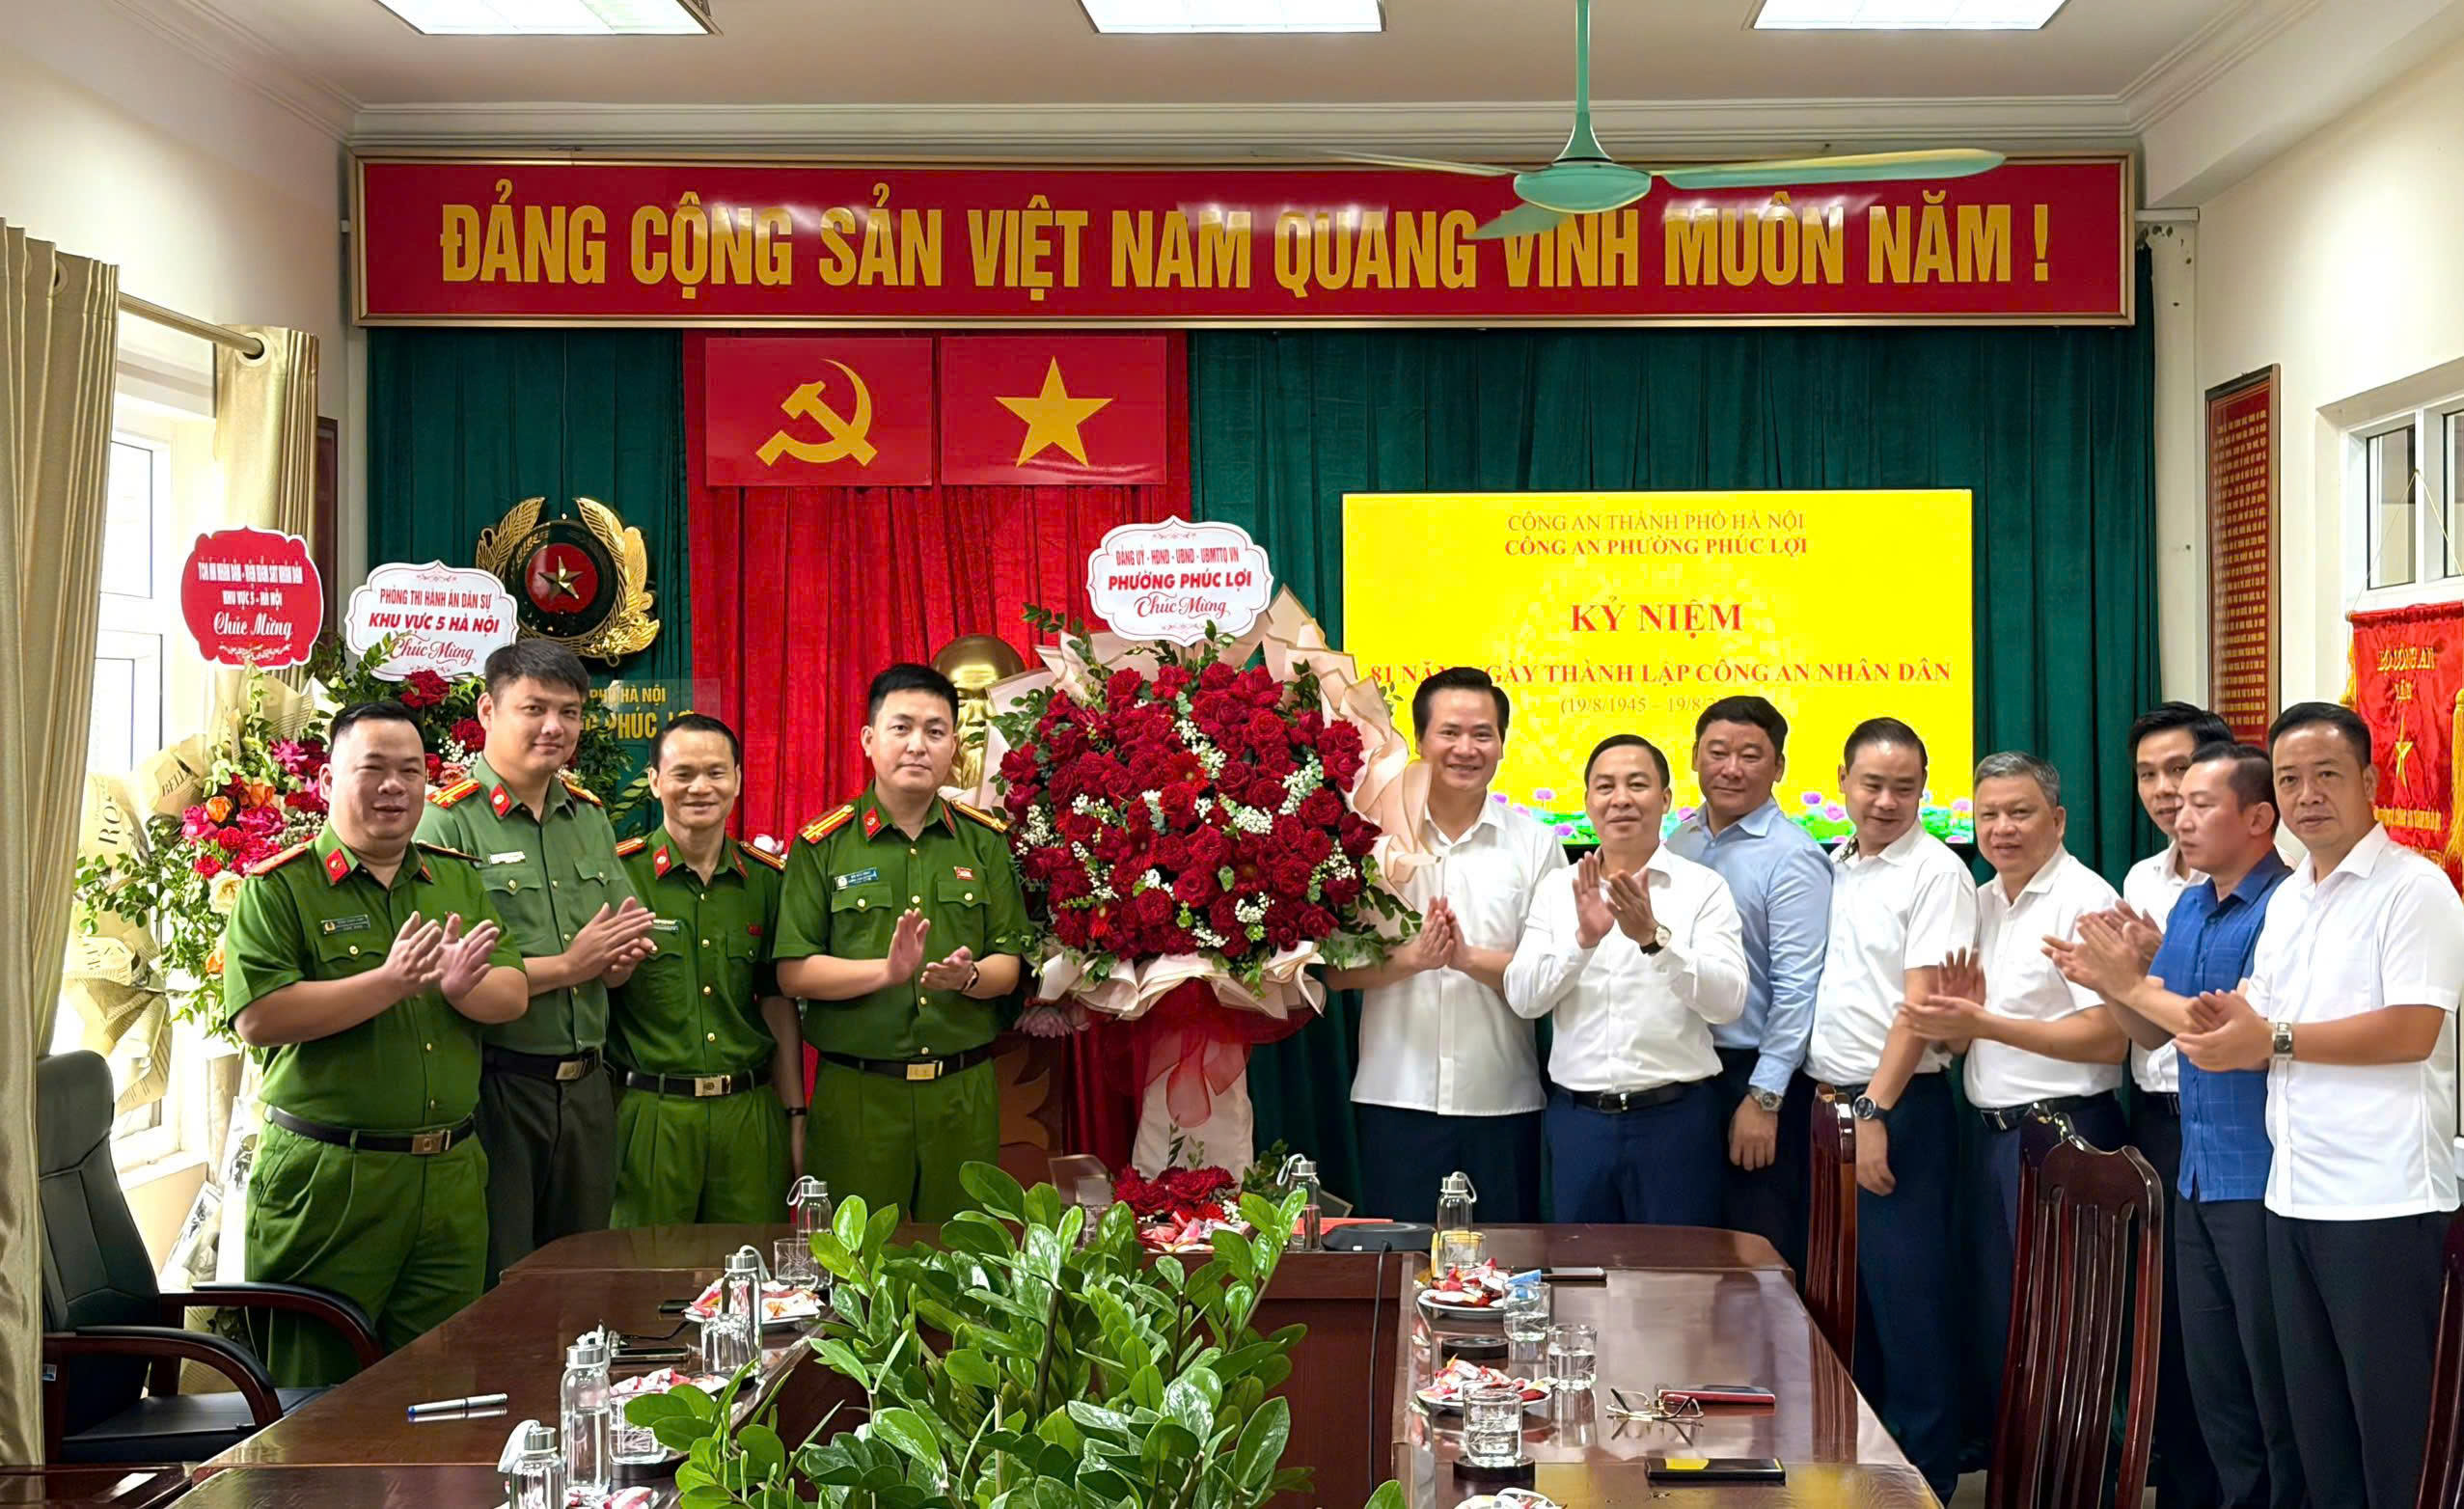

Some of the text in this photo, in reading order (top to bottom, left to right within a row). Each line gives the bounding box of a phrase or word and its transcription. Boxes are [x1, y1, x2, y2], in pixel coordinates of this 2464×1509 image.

[440, 178, 605, 284] ĐẢNG
[631, 191, 792, 299] CỘNG
[818, 183, 942, 286] SẢN
[967, 195, 1088, 300] VIỆT
[1111, 209, 1250, 288] NAM
[1273, 209, 1477, 298] QUANG
[1664, 191, 1845, 286] MUÔN
[1868, 190, 2011, 284] NĂM
[2033, 204, 2047, 282] !
[1508, 510, 1804, 532] CÔNG AN THÀNH PHỐ HÀ NỘI
[1115, 545, 1135, 565] ĐẢNG
[1176, 548, 1194, 563] UBND
[1229, 547, 1240, 562] VN
[1505, 535, 1807, 557] CÔNG AN PHƯỜNG PHÚC LỢI
[1109, 568, 1252, 591] PHƯỜNG PHÚC LỢI
[380, 585, 493, 613] PHÒNG THI HÀNH ÁN DÂN SỰ
[1134, 591, 1230, 619] Chúc Mừng
[214, 612, 292, 641] Chúc Mừng
[369, 612, 500, 637] KHU VỰC 5 HÀ NỘI
[1571, 595, 1742, 640] KỶ NIỆM
[427, 641, 477, 666] Mừng
[1371, 657, 1950, 687] 81 NĂ GÀY THÀNH LẬP CÔNG AN NHÂN DÂN
[620, 684, 639, 702] HÀ
[642, 683, 667, 705] NỘI
[1561, 697, 1646, 714] (19/8/1945
[98, 796, 123, 846] RO
